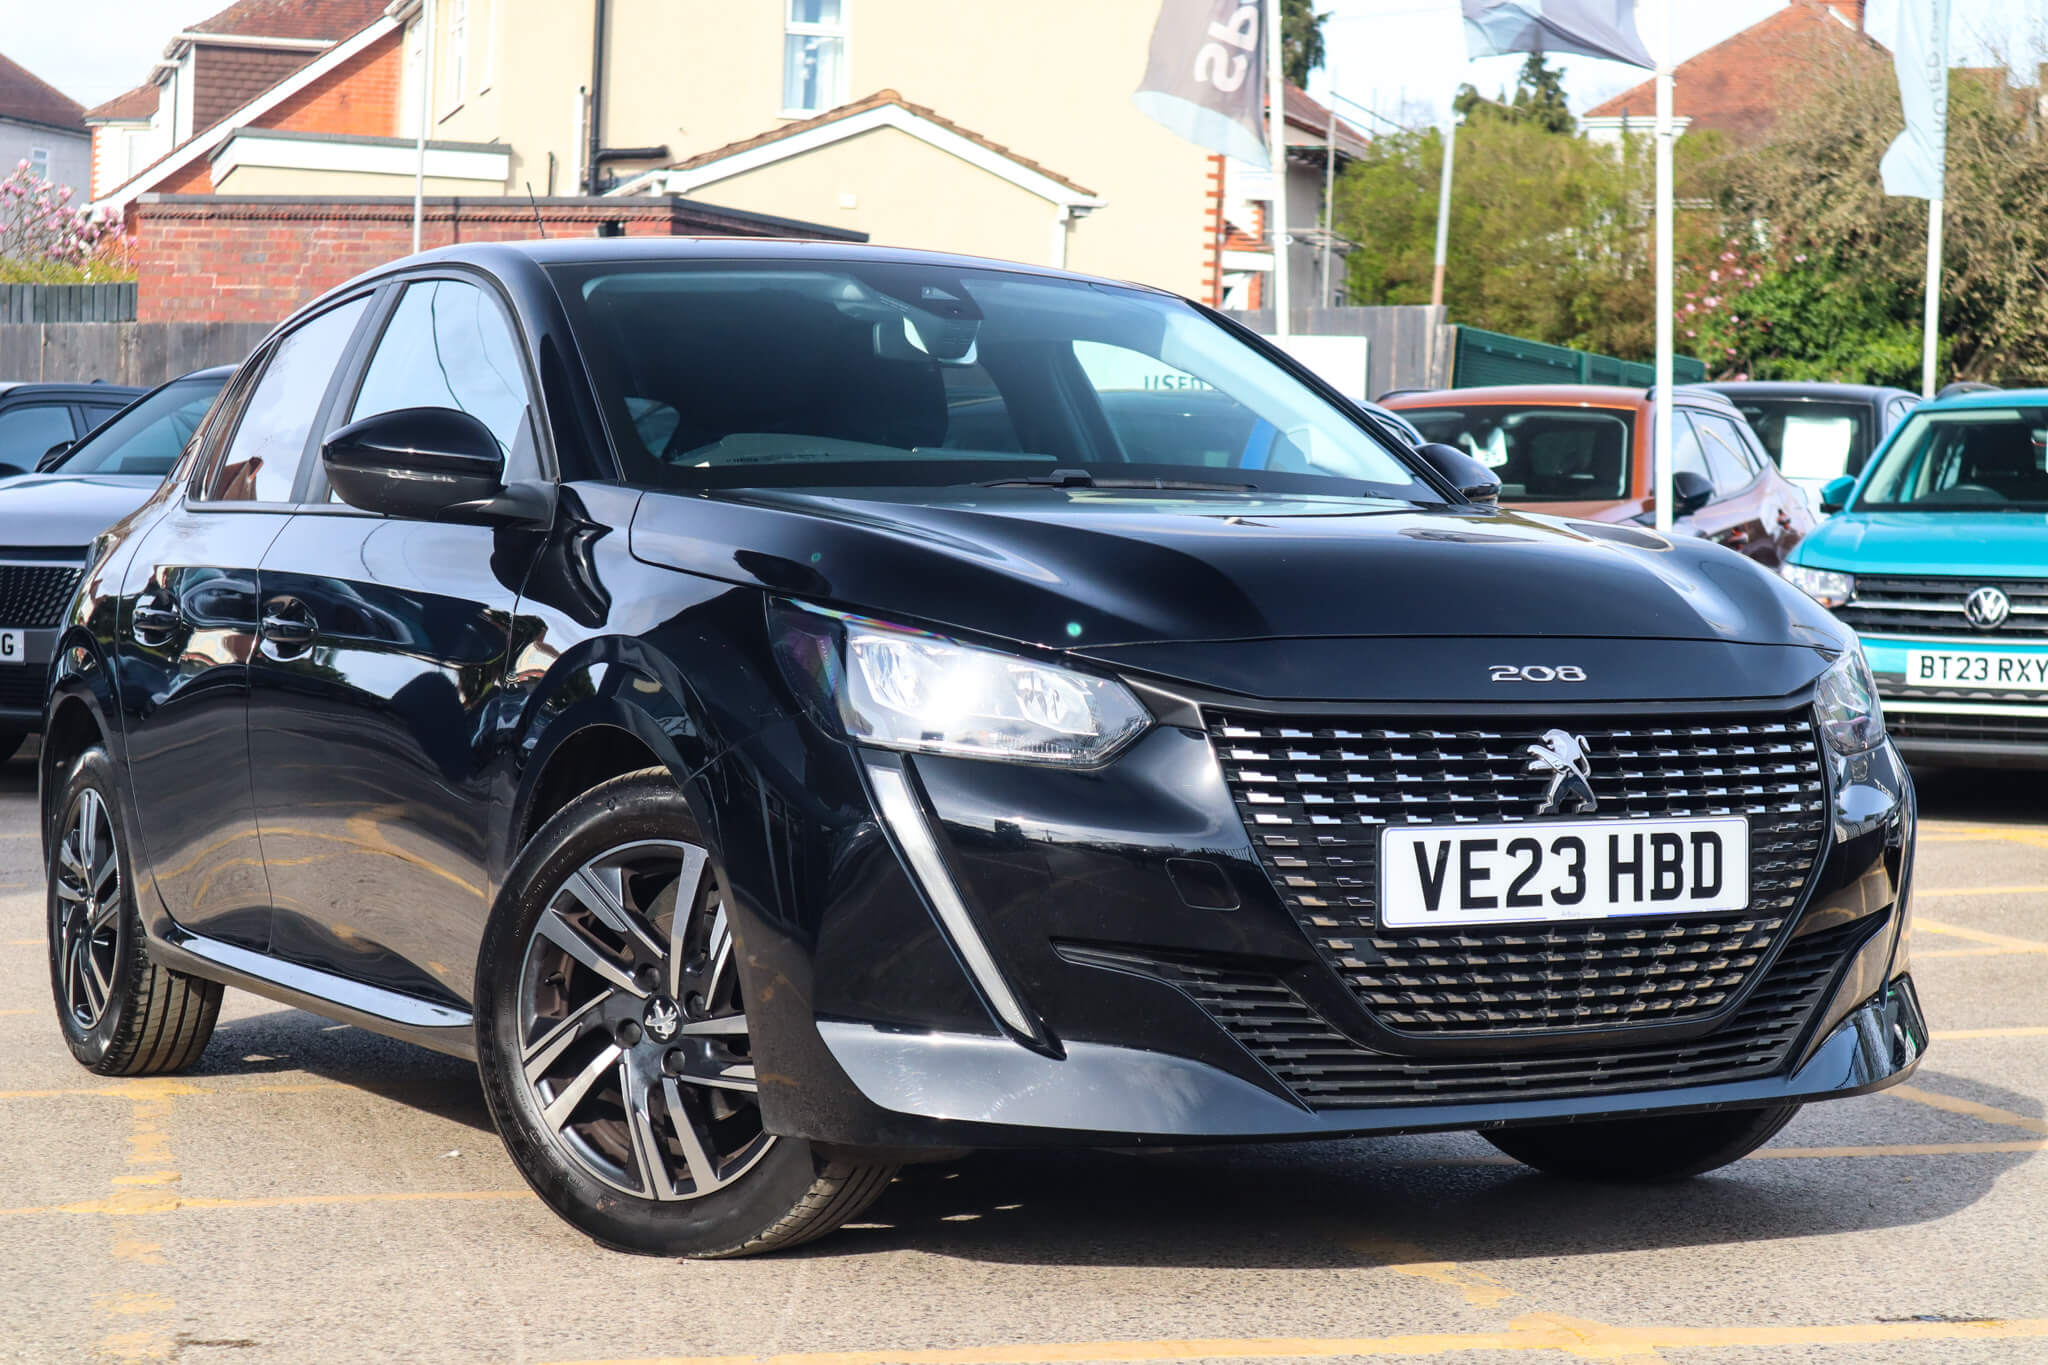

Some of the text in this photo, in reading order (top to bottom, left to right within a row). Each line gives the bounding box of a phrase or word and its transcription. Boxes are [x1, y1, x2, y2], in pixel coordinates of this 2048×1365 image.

[1488, 664, 1587, 681] 208
[1920, 655, 2048, 682] BT23 RXY
[1413, 831, 1723, 911] VE23 HBD
